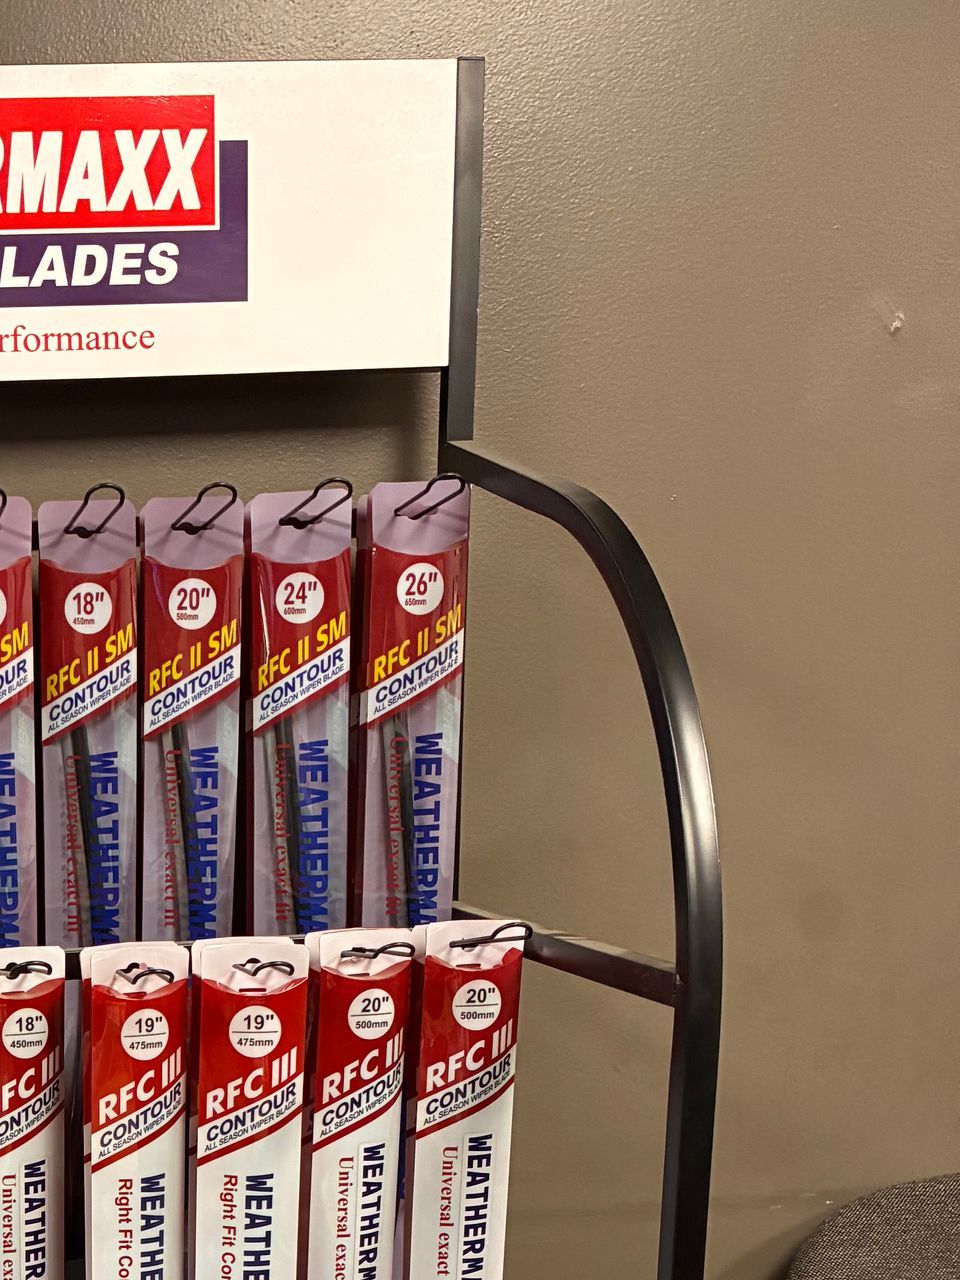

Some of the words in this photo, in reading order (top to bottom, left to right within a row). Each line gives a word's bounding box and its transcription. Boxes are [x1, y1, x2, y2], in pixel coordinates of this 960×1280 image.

[284, 581, 317, 605] 24"
[406, 572, 438, 596] 26"
[73, 592, 104, 615] 18"
[177, 587, 210, 610] 20"
[1, 622, 28, 661] SM
[258, 648, 290, 691] RFC
[298, 635, 309, 664] II
[317, 611, 346, 652] SM
[261, 648, 344, 710] CONTOUR
[376, 641, 458, 703] CONTOUR
[50, 659, 130, 721] CONTOUR
[151, 655, 234, 716] CONTOUR
[362, 997, 389, 1012] 20"
[466, 987, 495, 1003] 20"
[16, 1016, 42, 1032] 18"
[135, 1016, 163, 1033] 19"
[244, 1014, 274, 1030] 19"
[356, 1021, 388, 1029] 500mm
[461, 1011, 494, 1019] 500mm
[10, 1040, 42, 1048] 450mm
[129, 1041, 162, 1050] 475mm
[237, 1038, 273, 1046] 475mm
[426, 1040, 485, 1093] RFC
[492, 1019, 513, 1060] III
[206, 1068, 264, 1119] RFC
[272, 1047, 297, 1086] III
[322, 1061, 401, 1126] CONTOUR
[426, 1053, 511, 1114] CONTOUR
[100, 1082, 181, 1147] CONTOUR
[207, 1083, 296, 1142] CONTOUR
